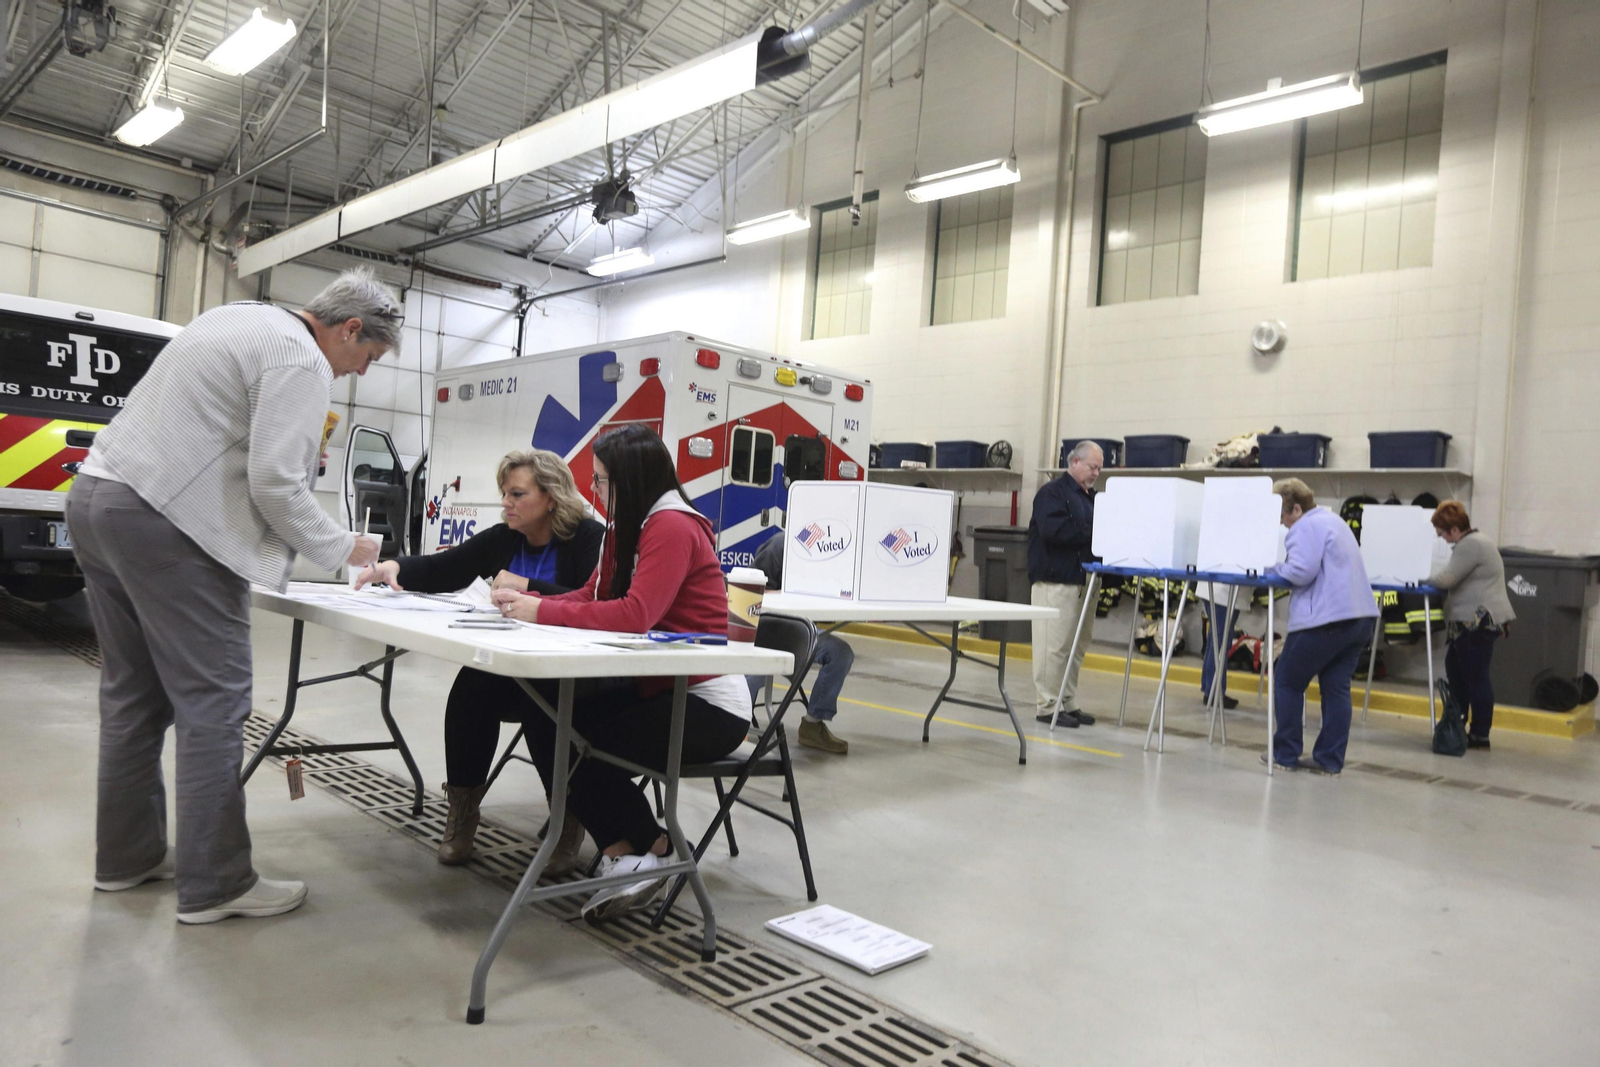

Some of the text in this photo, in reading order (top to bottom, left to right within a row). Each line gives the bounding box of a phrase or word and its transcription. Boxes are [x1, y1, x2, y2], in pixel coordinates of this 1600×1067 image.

[31, 385, 92, 403] DUTY
[479, 376, 518, 397] MEDIC 21
[696, 391, 717, 403] EMS
[844, 418, 860, 432] M21
[442, 506, 478, 517] INDIANAPOLIS
[439, 518, 477, 545] EMS
[827, 525, 831, 538] I
[913, 531, 918, 543] I
[816, 537, 844, 553] Voted
[903, 543, 931, 559] Voted
